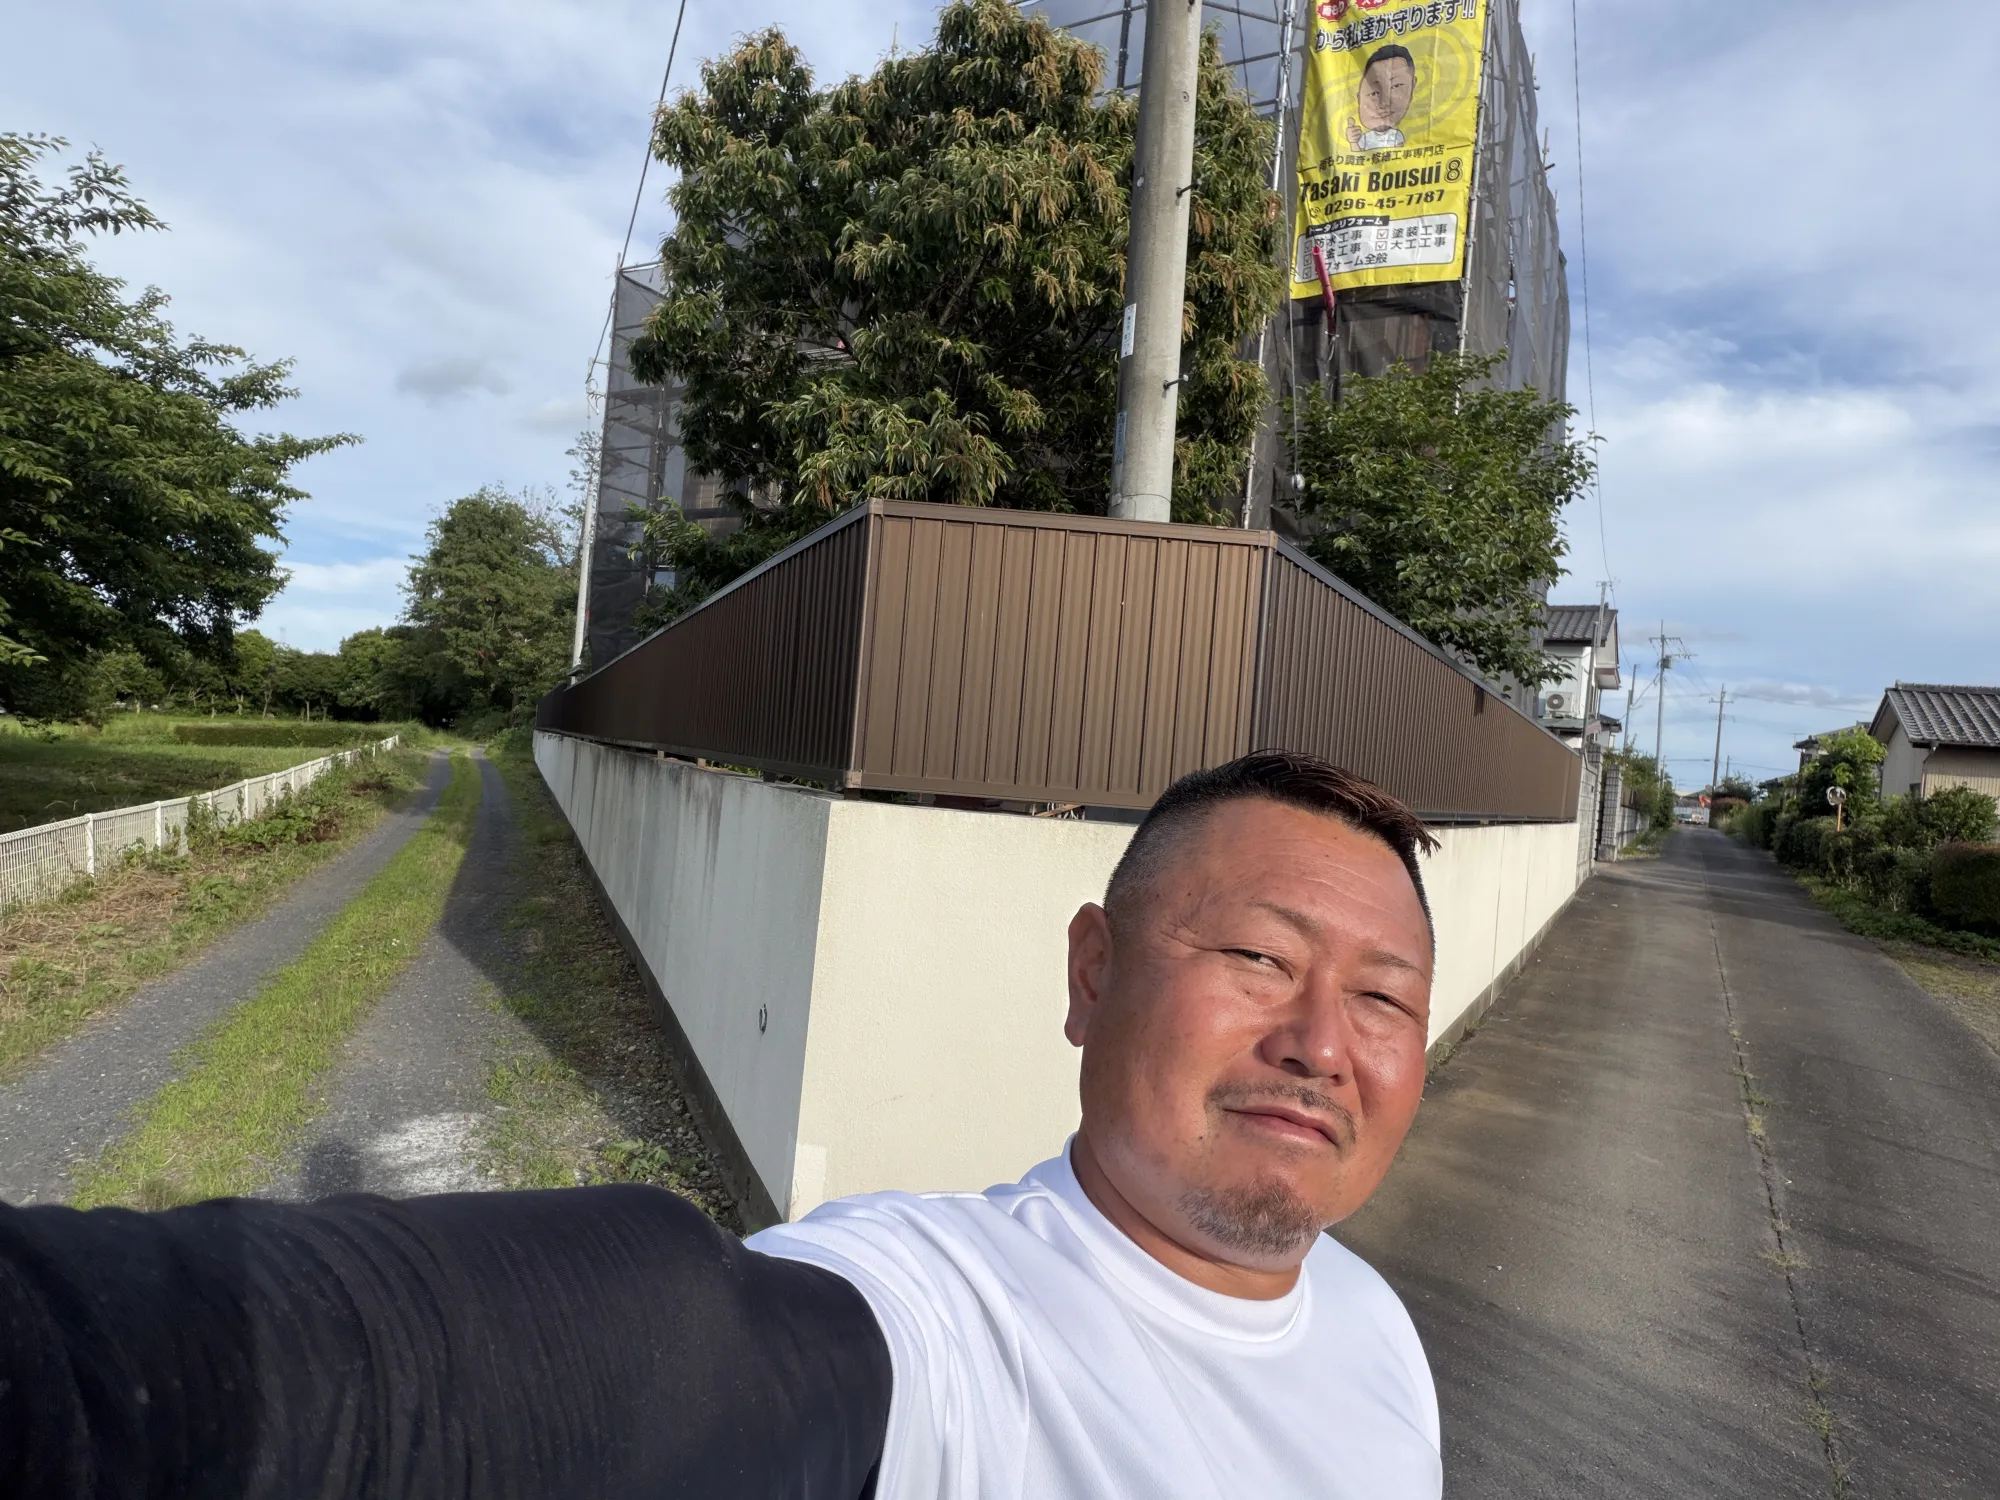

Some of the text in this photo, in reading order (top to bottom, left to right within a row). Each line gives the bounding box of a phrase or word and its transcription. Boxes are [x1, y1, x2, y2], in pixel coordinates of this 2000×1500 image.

[1300, 172, 1360, 203] Tasaki
[1367, 162, 1441, 192] Bousui
[1325, 189, 1445, 216] 0296-45-7787
[1308, 217, 1383, 235] トータルリフォーム
[1391, 223, 1447, 239] 塗装工事
[1320, 242, 1361, 260] 金工事
[1390, 236, 1446, 250] 大工工事
[1325, 253, 1388, 271] フォーム全般
